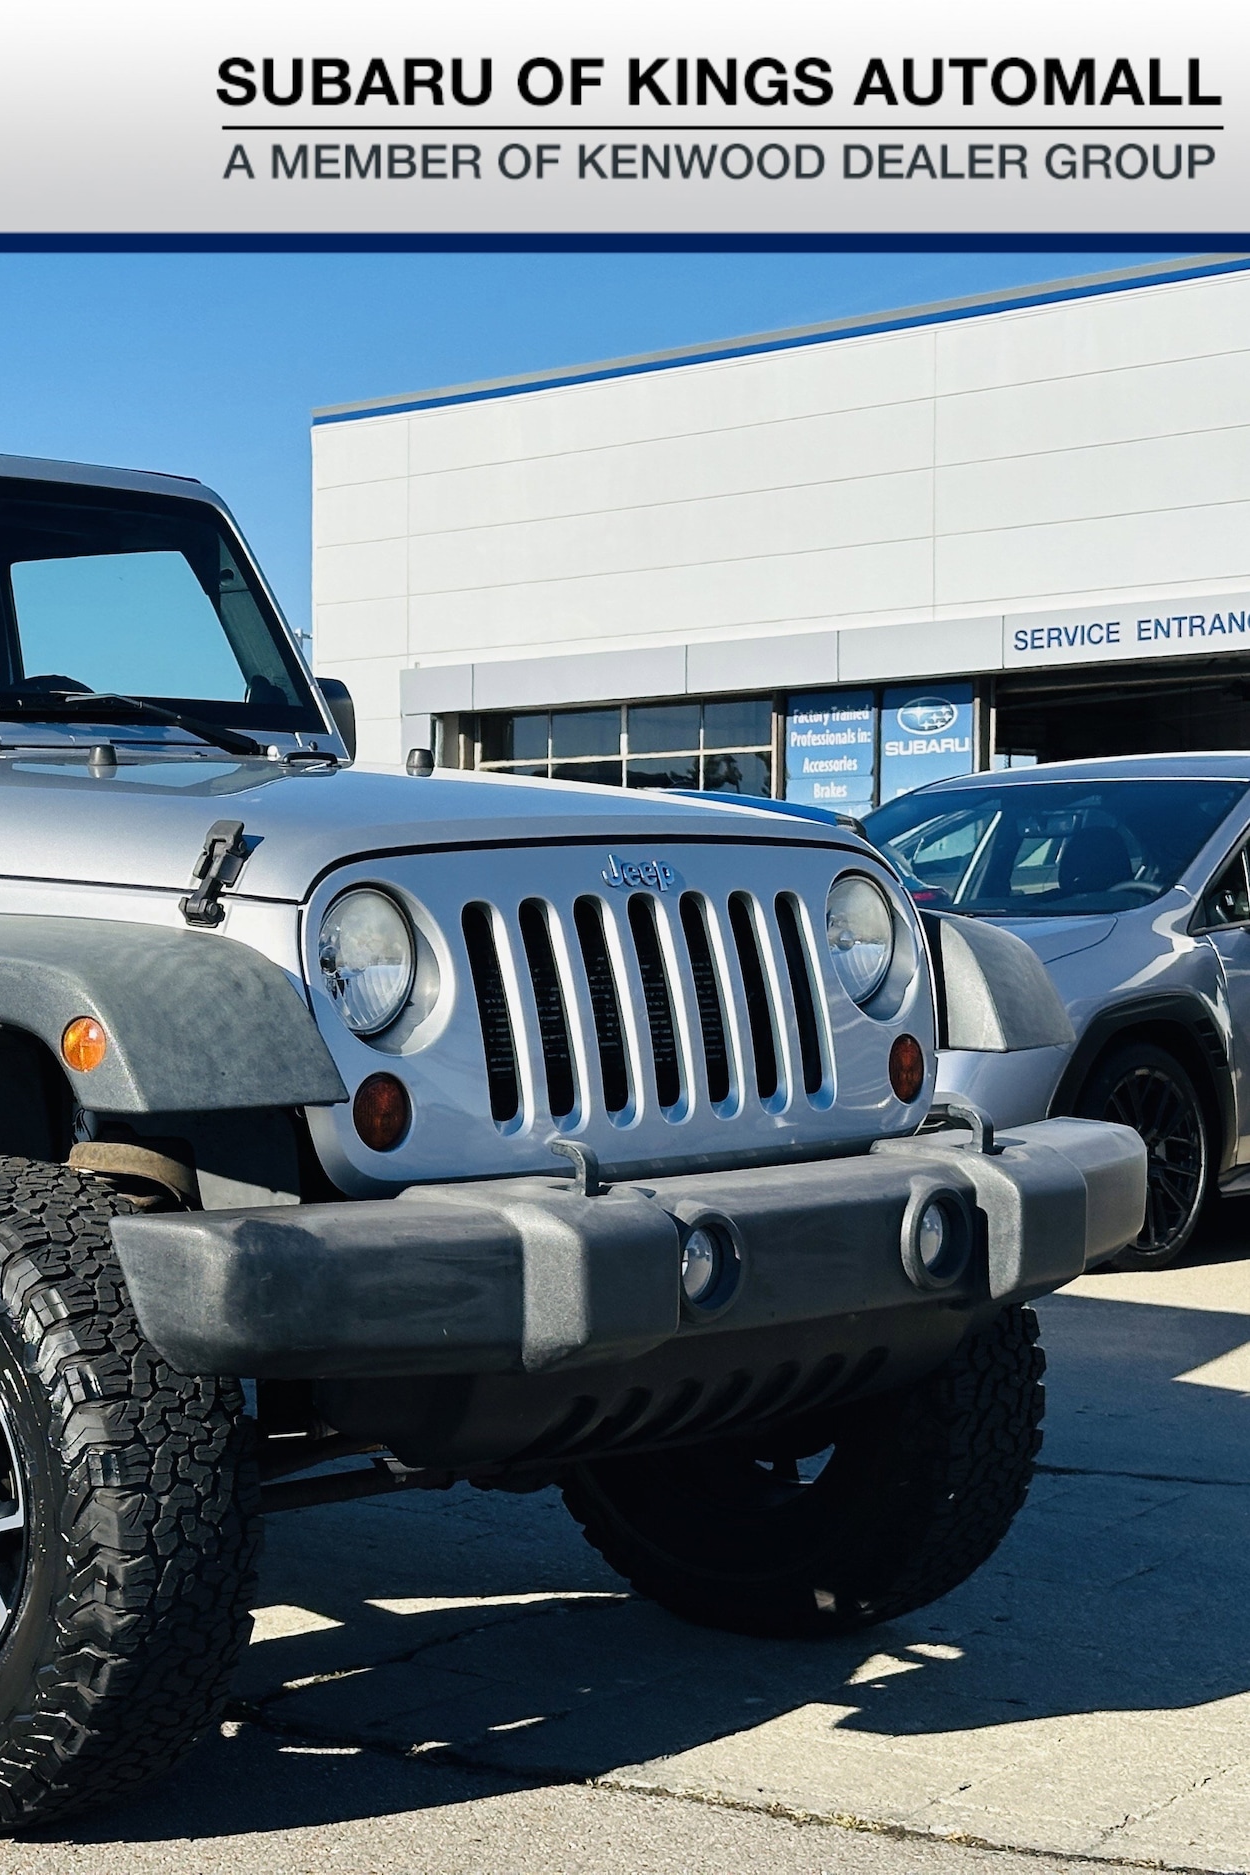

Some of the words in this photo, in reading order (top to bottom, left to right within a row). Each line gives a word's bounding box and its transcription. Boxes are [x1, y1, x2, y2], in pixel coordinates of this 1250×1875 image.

[1014, 621, 1120, 651] SERVICE
[1137, 610, 1250, 641] ENTRAN
[793, 708, 829, 726] Factory
[831, 705, 870, 721] Trained
[791, 728, 856, 748] Professionals
[857, 727, 872, 743] in:
[885, 737, 970, 756] SUBARU
[803, 755, 858, 774] Accessories
[813, 780, 848, 799] Brakes
[602, 853, 675, 892] Jeep
